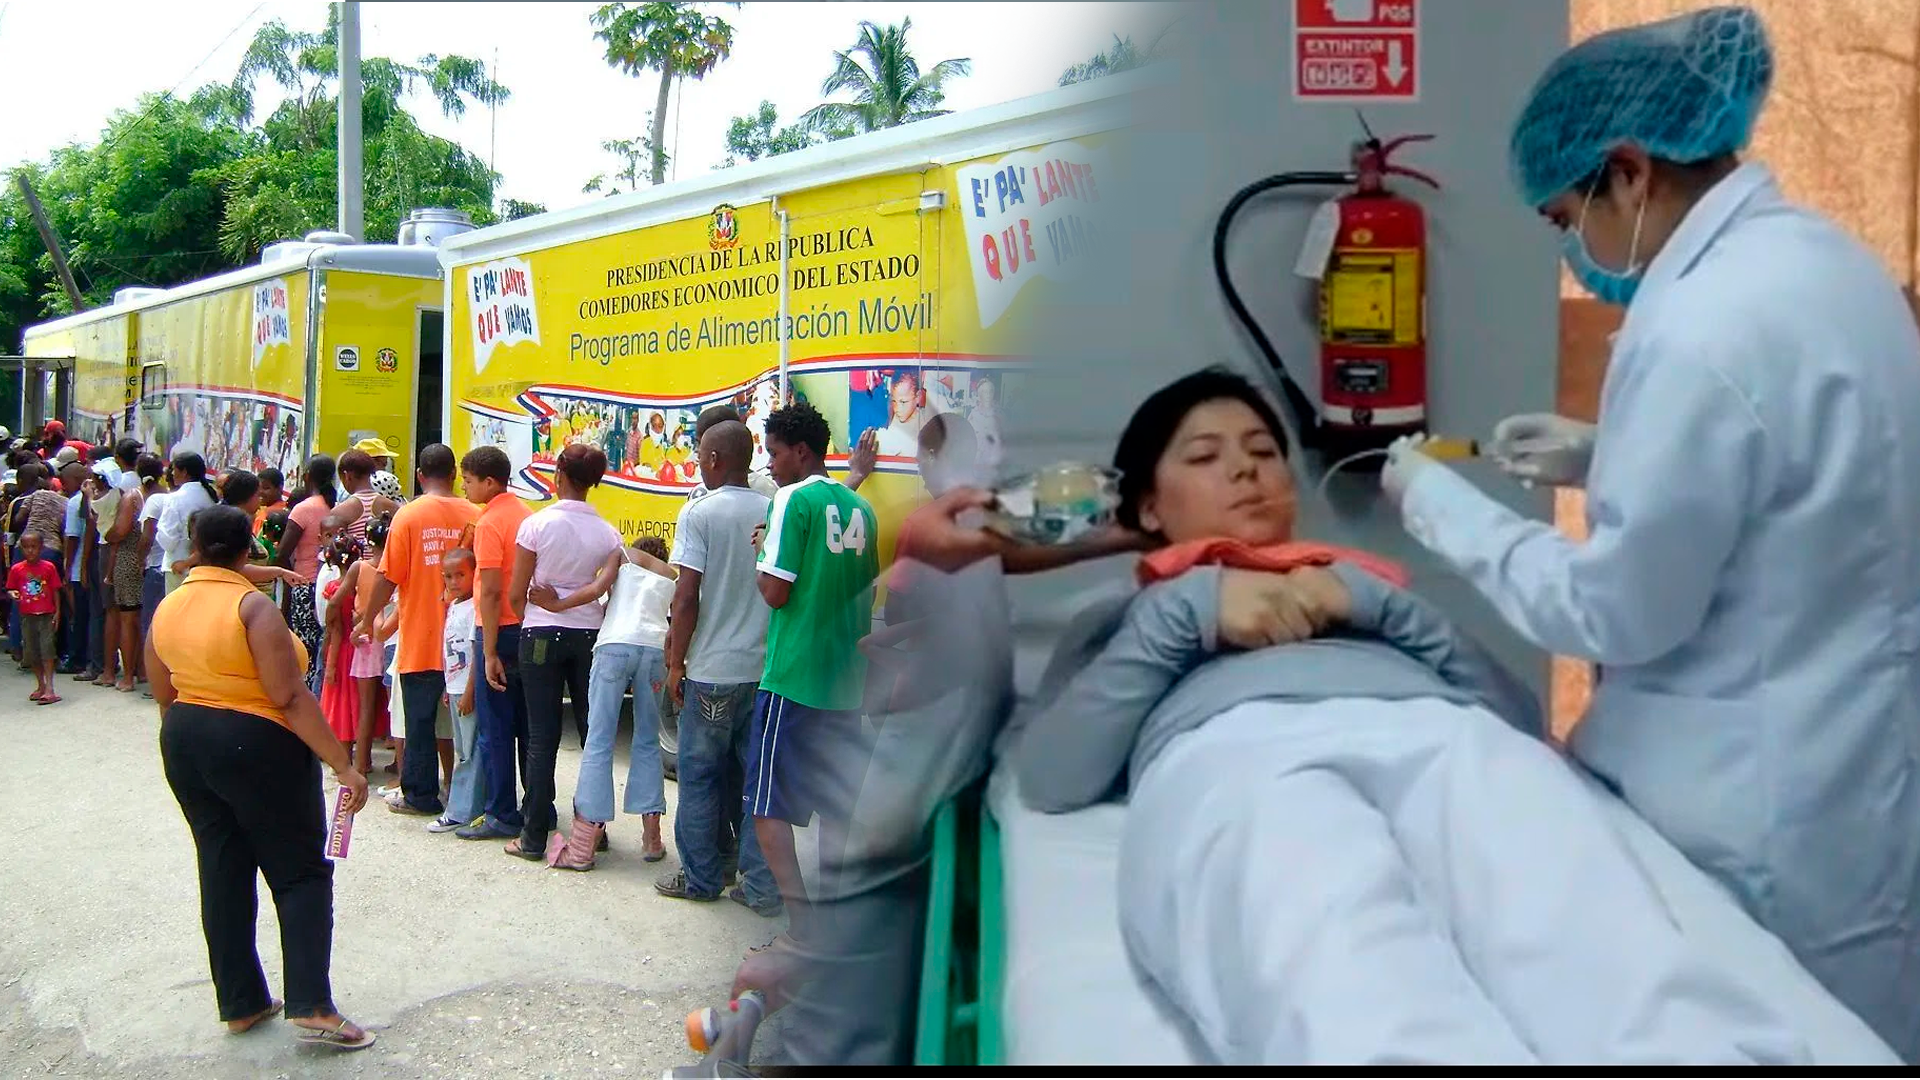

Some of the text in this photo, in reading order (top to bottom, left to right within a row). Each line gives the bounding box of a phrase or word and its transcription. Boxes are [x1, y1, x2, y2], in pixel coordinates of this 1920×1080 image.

[1305, 40, 1384, 53] EXTINTOR
[971, 159, 1100, 217] E' PA' LANTE
[607, 226, 875, 288] PRESIDENCIA DE LA RPUBLICA
[983, 219, 1036, 282] QUE
[500, 267, 528, 297] LANTE
[579, 254, 920, 320] COMEDORES ECONOMICO DEL ESTADO
[478, 303, 532, 344] QUE VAMOS
[570, 293, 932, 365] Programa de Alimentación Móvil
[422, 528, 438, 539] JUST
[619, 519, 677, 539] UN APORT
[825, 504, 866, 556] 64
[331, 826, 344, 855] EDDY
